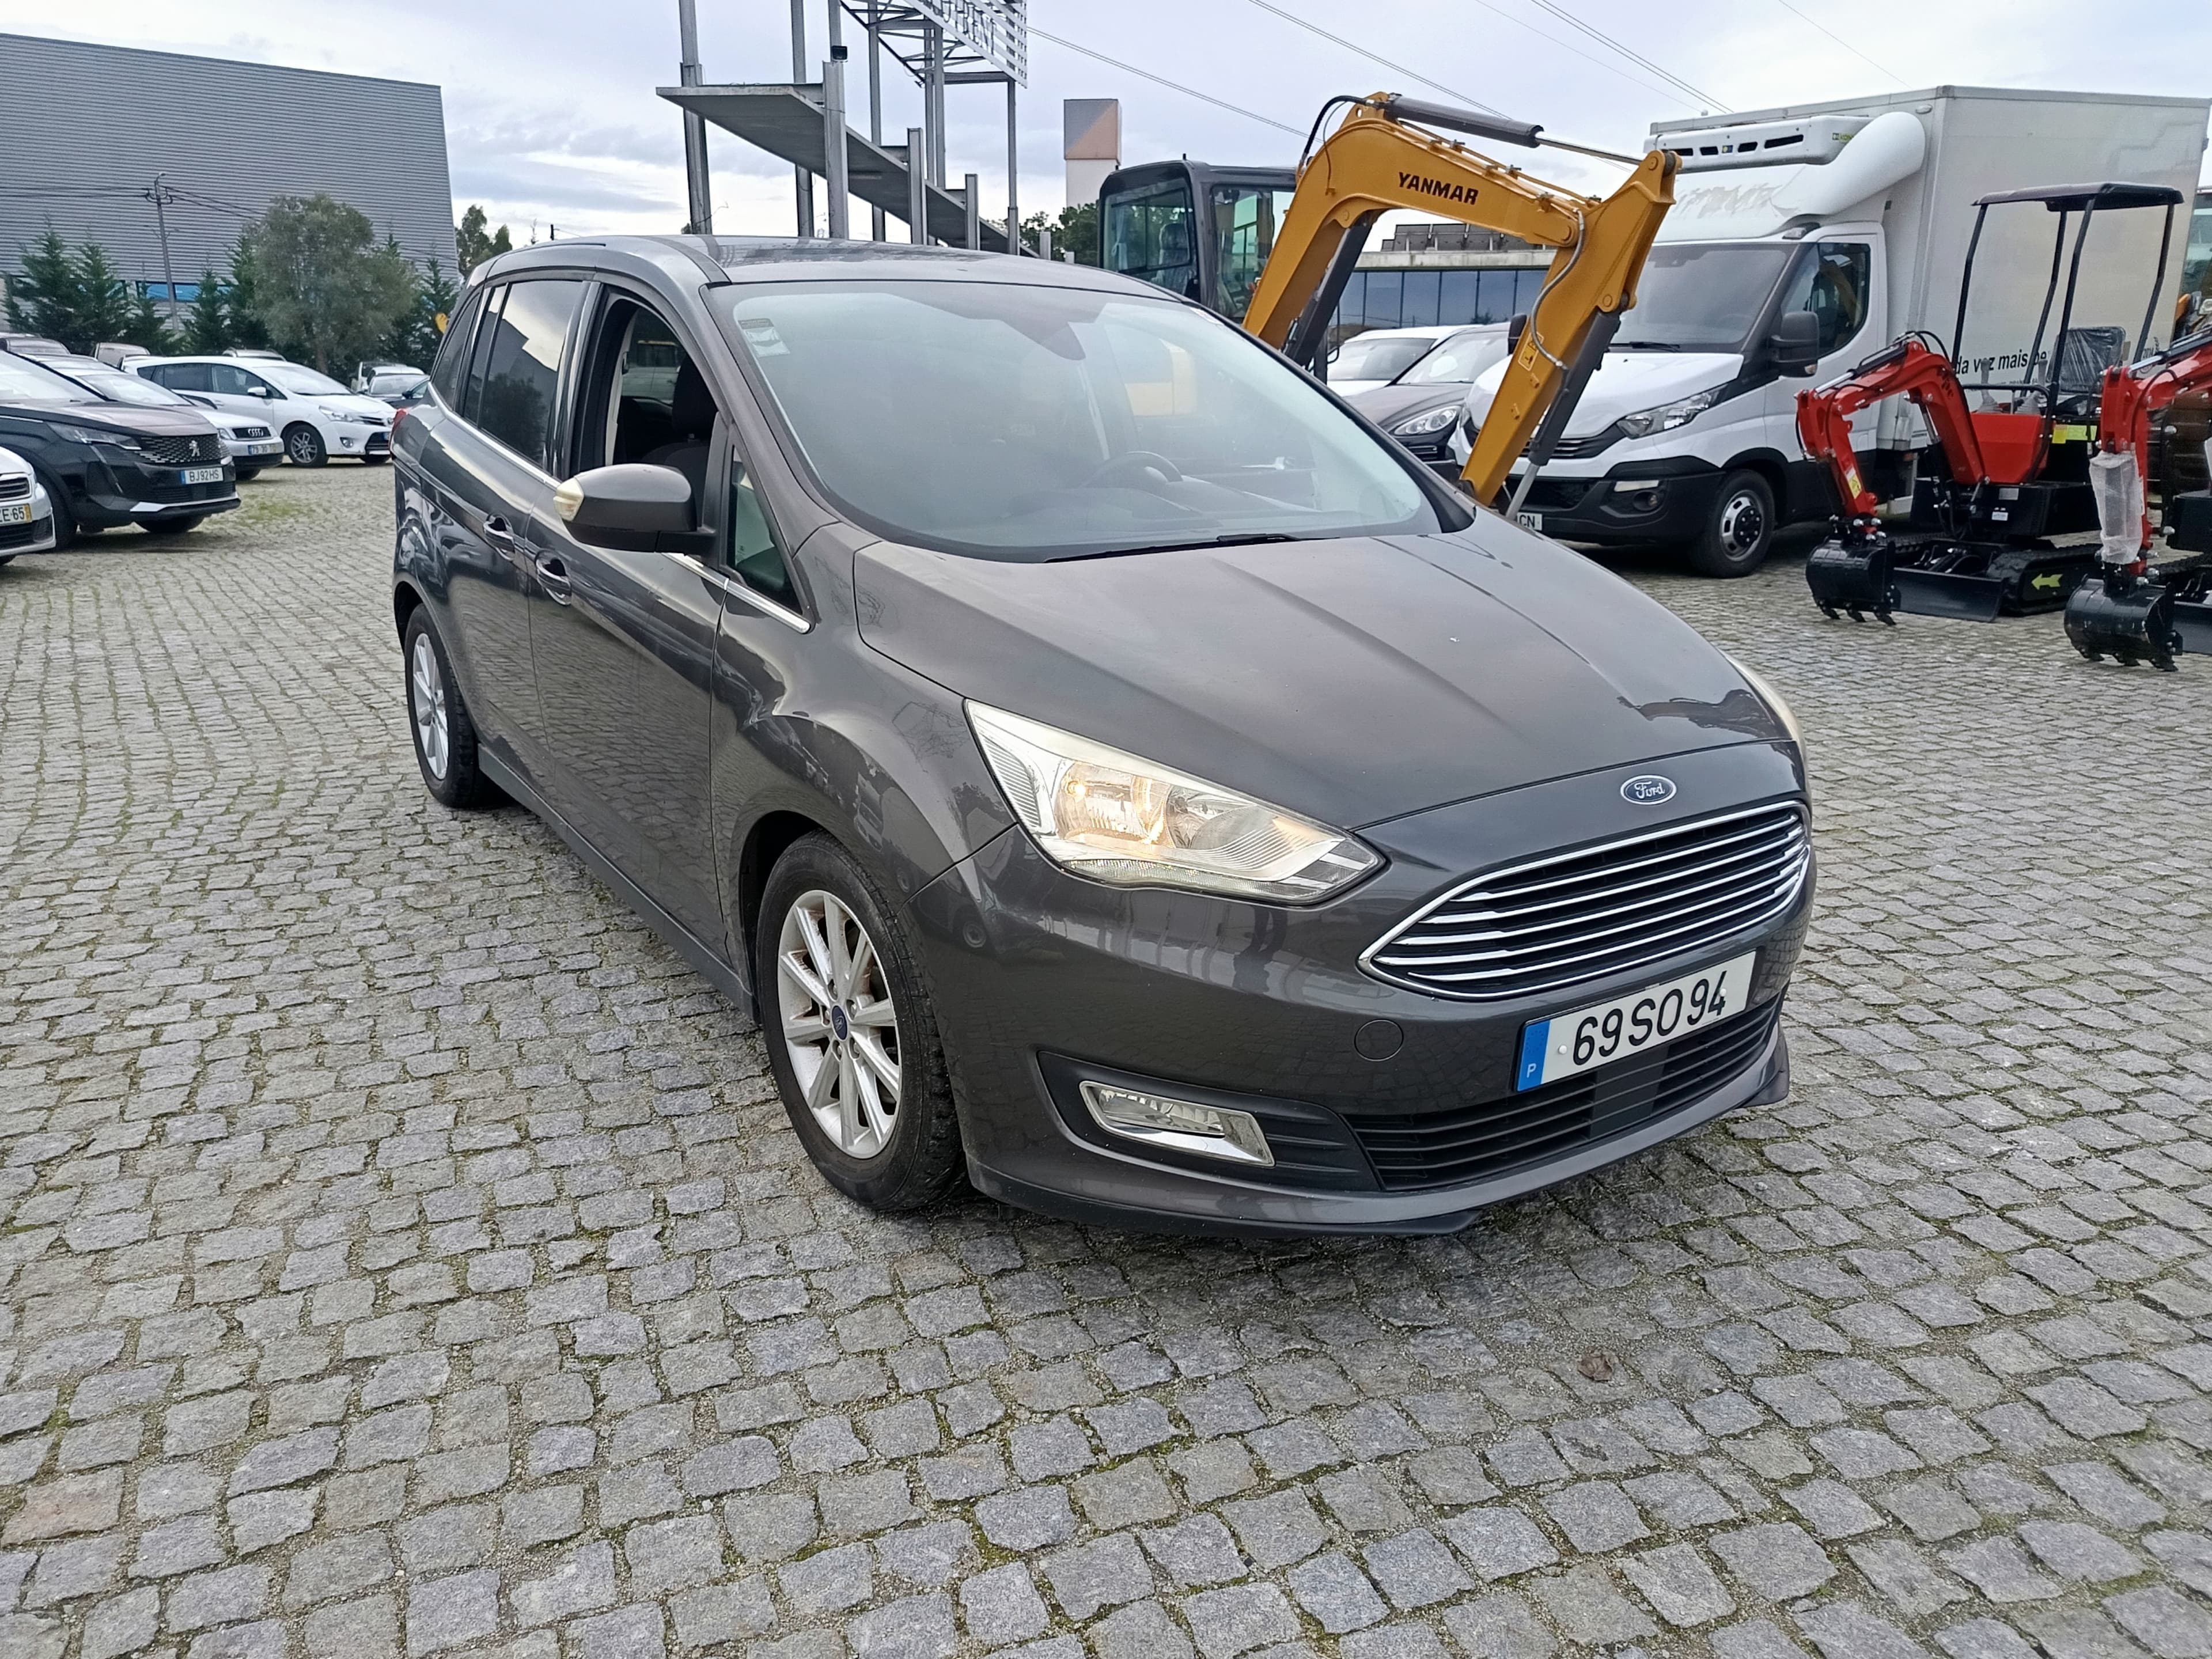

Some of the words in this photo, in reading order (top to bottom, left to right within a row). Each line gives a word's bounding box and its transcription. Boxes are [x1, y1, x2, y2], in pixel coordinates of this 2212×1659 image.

[1399, 172, 1479, 205] YANMAR
[1974, 356, 1995, 373] vz
[1998, 349, 2028, 370] mais
[189, 469, 219, 482] BJ92HS
[1634, 781, 1665, 799] Ford
[1573, 970, 1728, 1066] 69SO94
[1527, 1063, 1536, 1078] P
